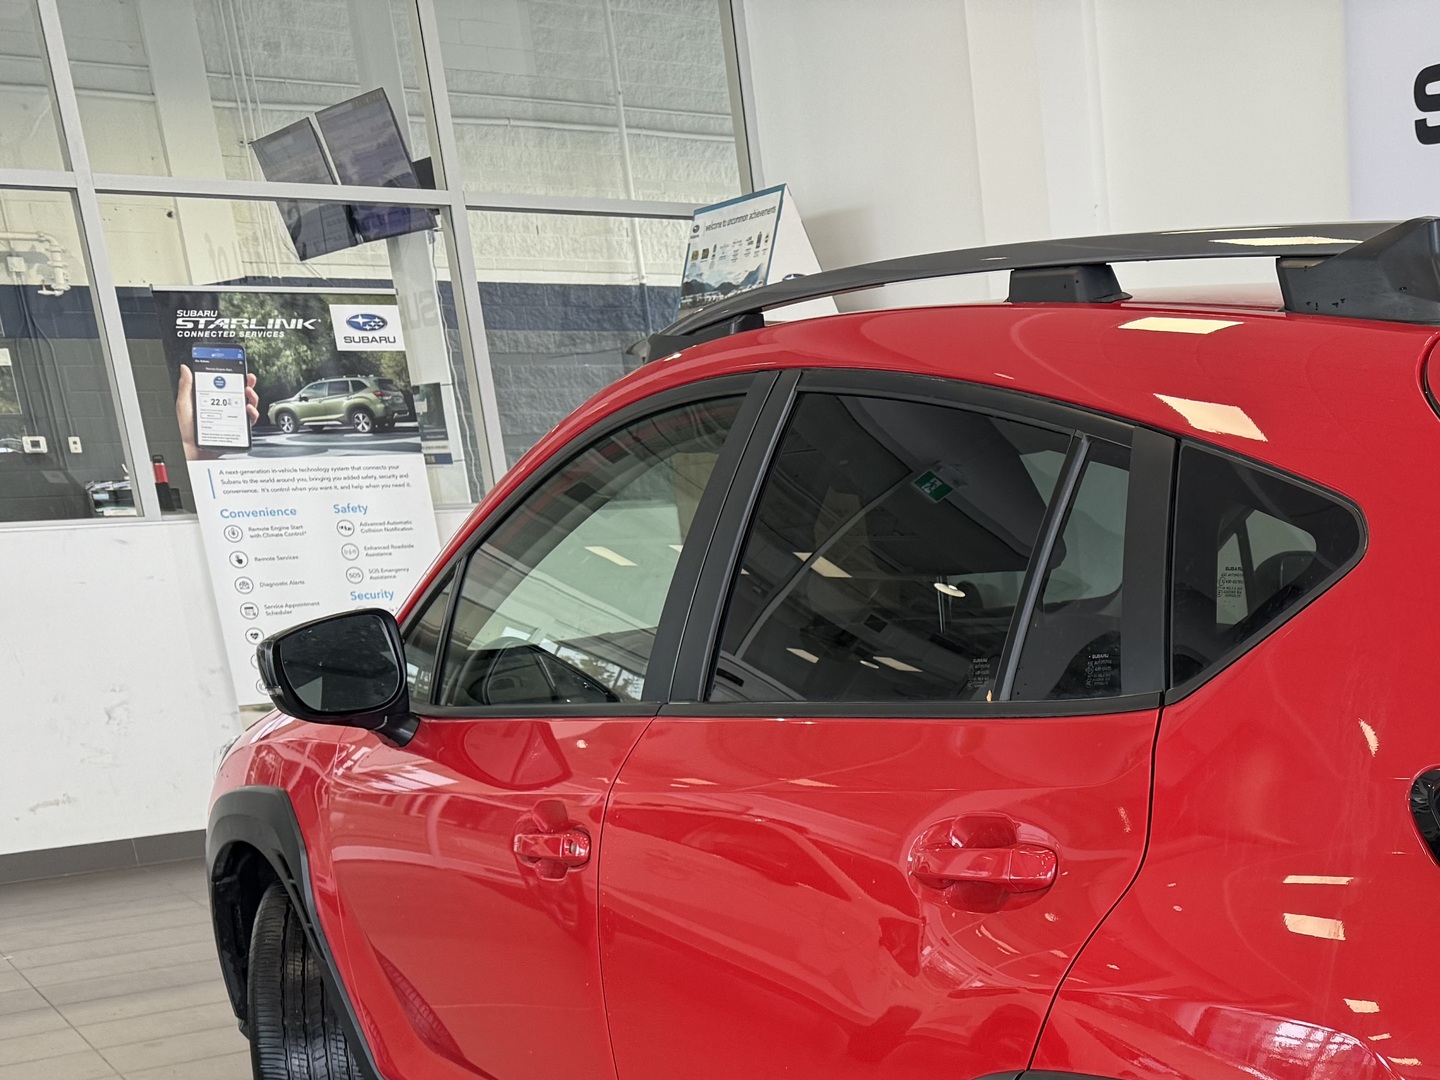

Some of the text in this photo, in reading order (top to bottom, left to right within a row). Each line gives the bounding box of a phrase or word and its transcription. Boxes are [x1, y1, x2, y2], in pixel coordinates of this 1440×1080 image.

[343, 336, 396, 344] SUBARU
[211, 398, 227, 406] 22.0
[220, 507, 297, 519] Convenience
[333, 502, 368, 515] Safety
[350, 589, 394, 601] Security
